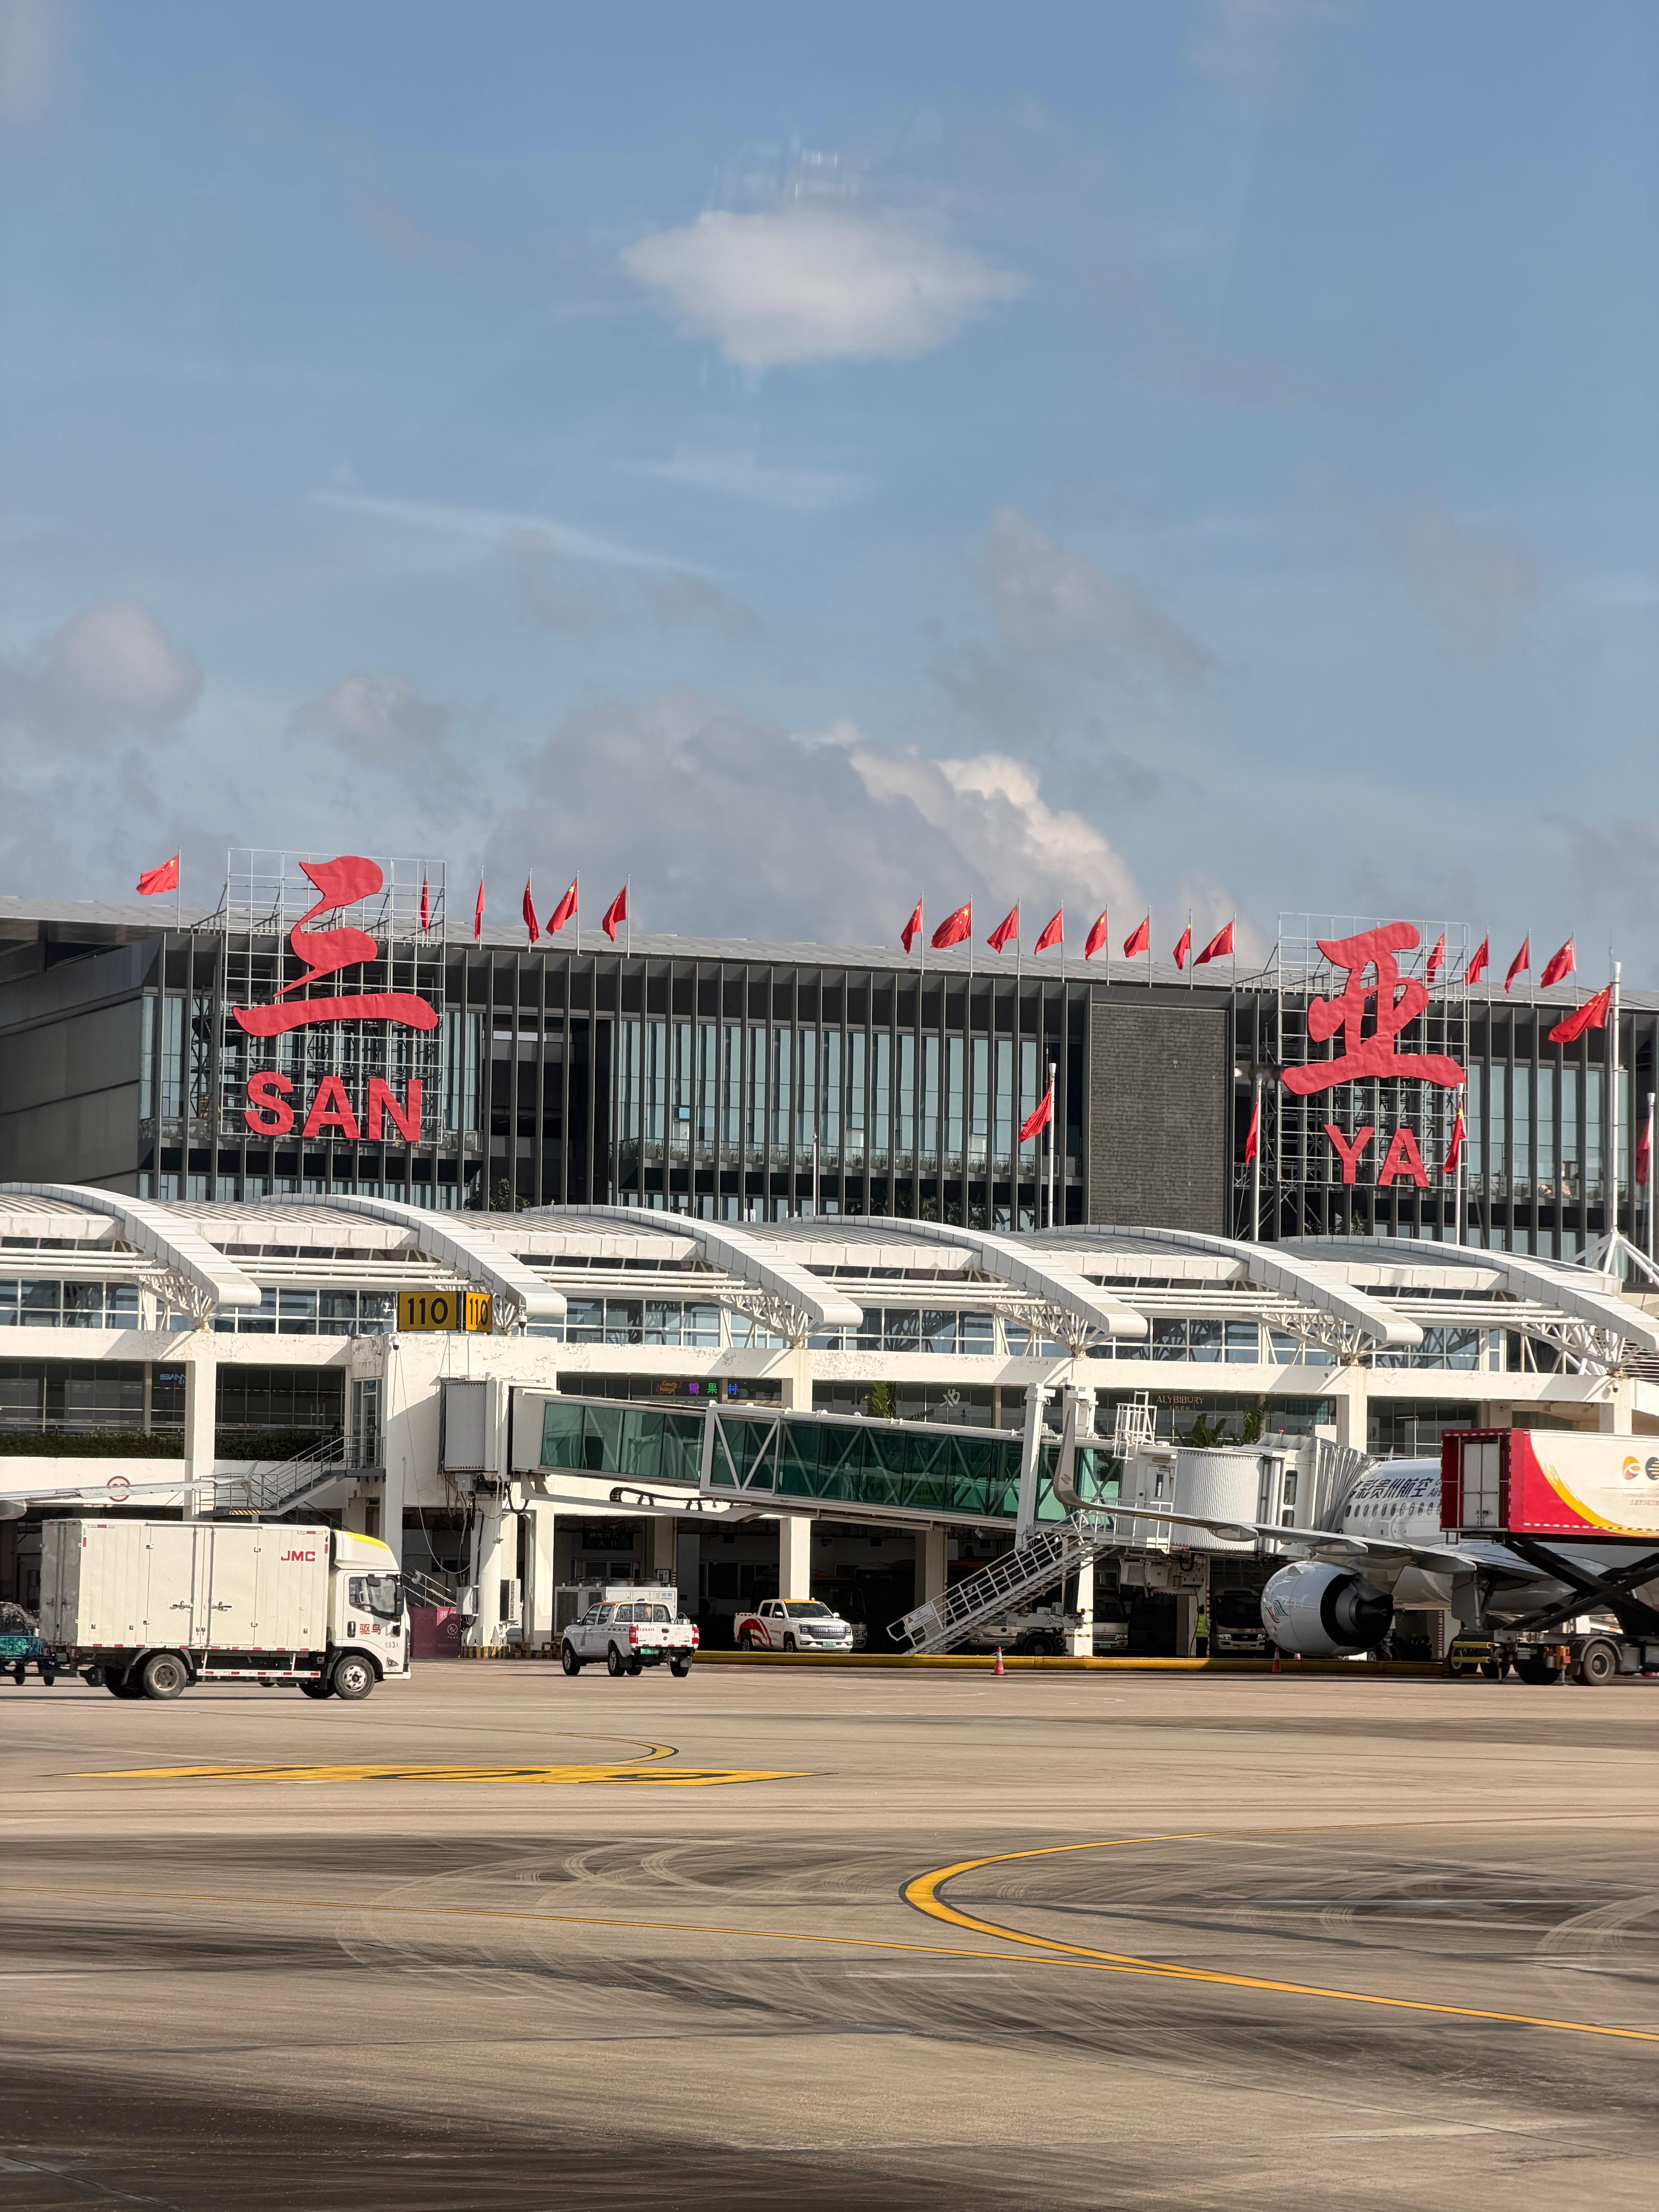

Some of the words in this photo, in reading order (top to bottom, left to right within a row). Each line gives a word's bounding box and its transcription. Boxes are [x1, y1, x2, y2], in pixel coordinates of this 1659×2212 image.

[1281, 921, 1466, 1096] 亚
[244, 1072, 422, 1142] SAN
[1323, 1124, 1430, 1188] YA
[408, 1297, 448, 1324] 110
[470, 1298, 488, 1326] 110
[281, 1550, 315, 1561] JMC
[359, 1623, 381, 1635] 驱鸟
